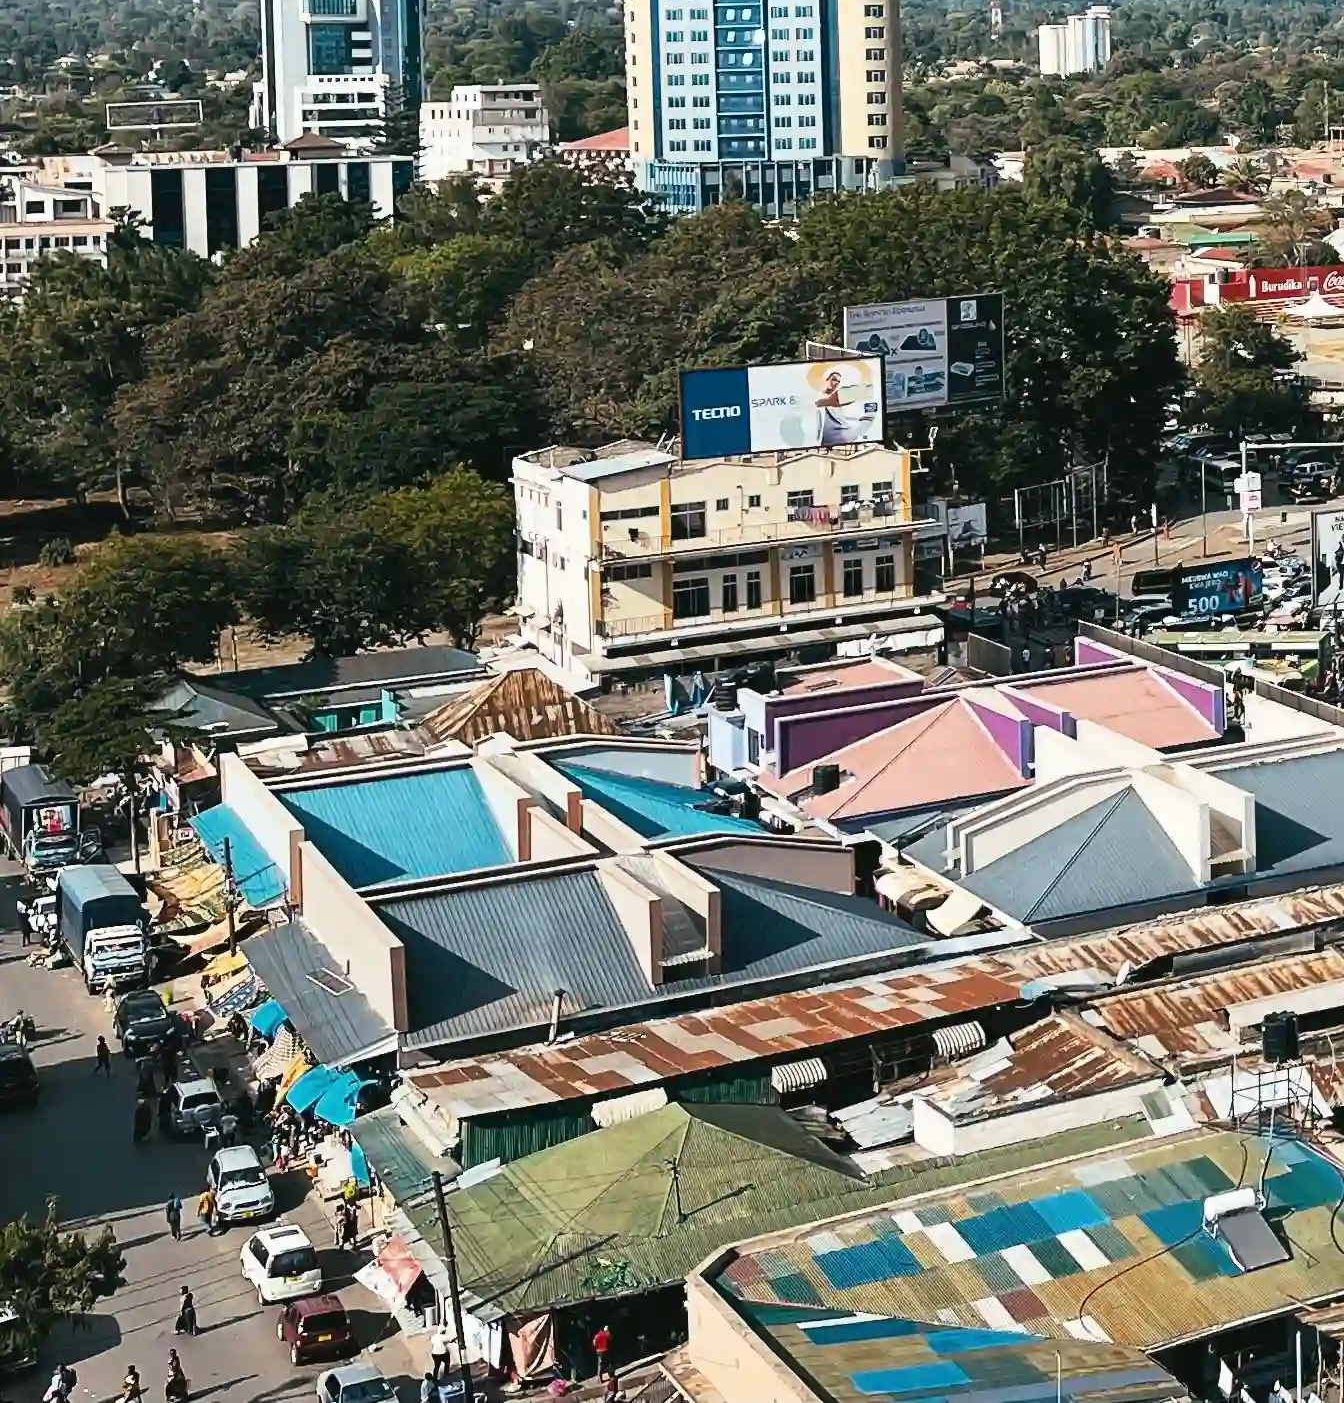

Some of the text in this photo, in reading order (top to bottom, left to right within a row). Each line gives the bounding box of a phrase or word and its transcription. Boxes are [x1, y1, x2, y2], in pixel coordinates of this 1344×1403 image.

[1262, 278, 1302, 293] Burudika
[751, 397, 786, 408] SPARK
[692, 405, 741, 421] TECNO
[1188, 595, 1220, 615] 500
